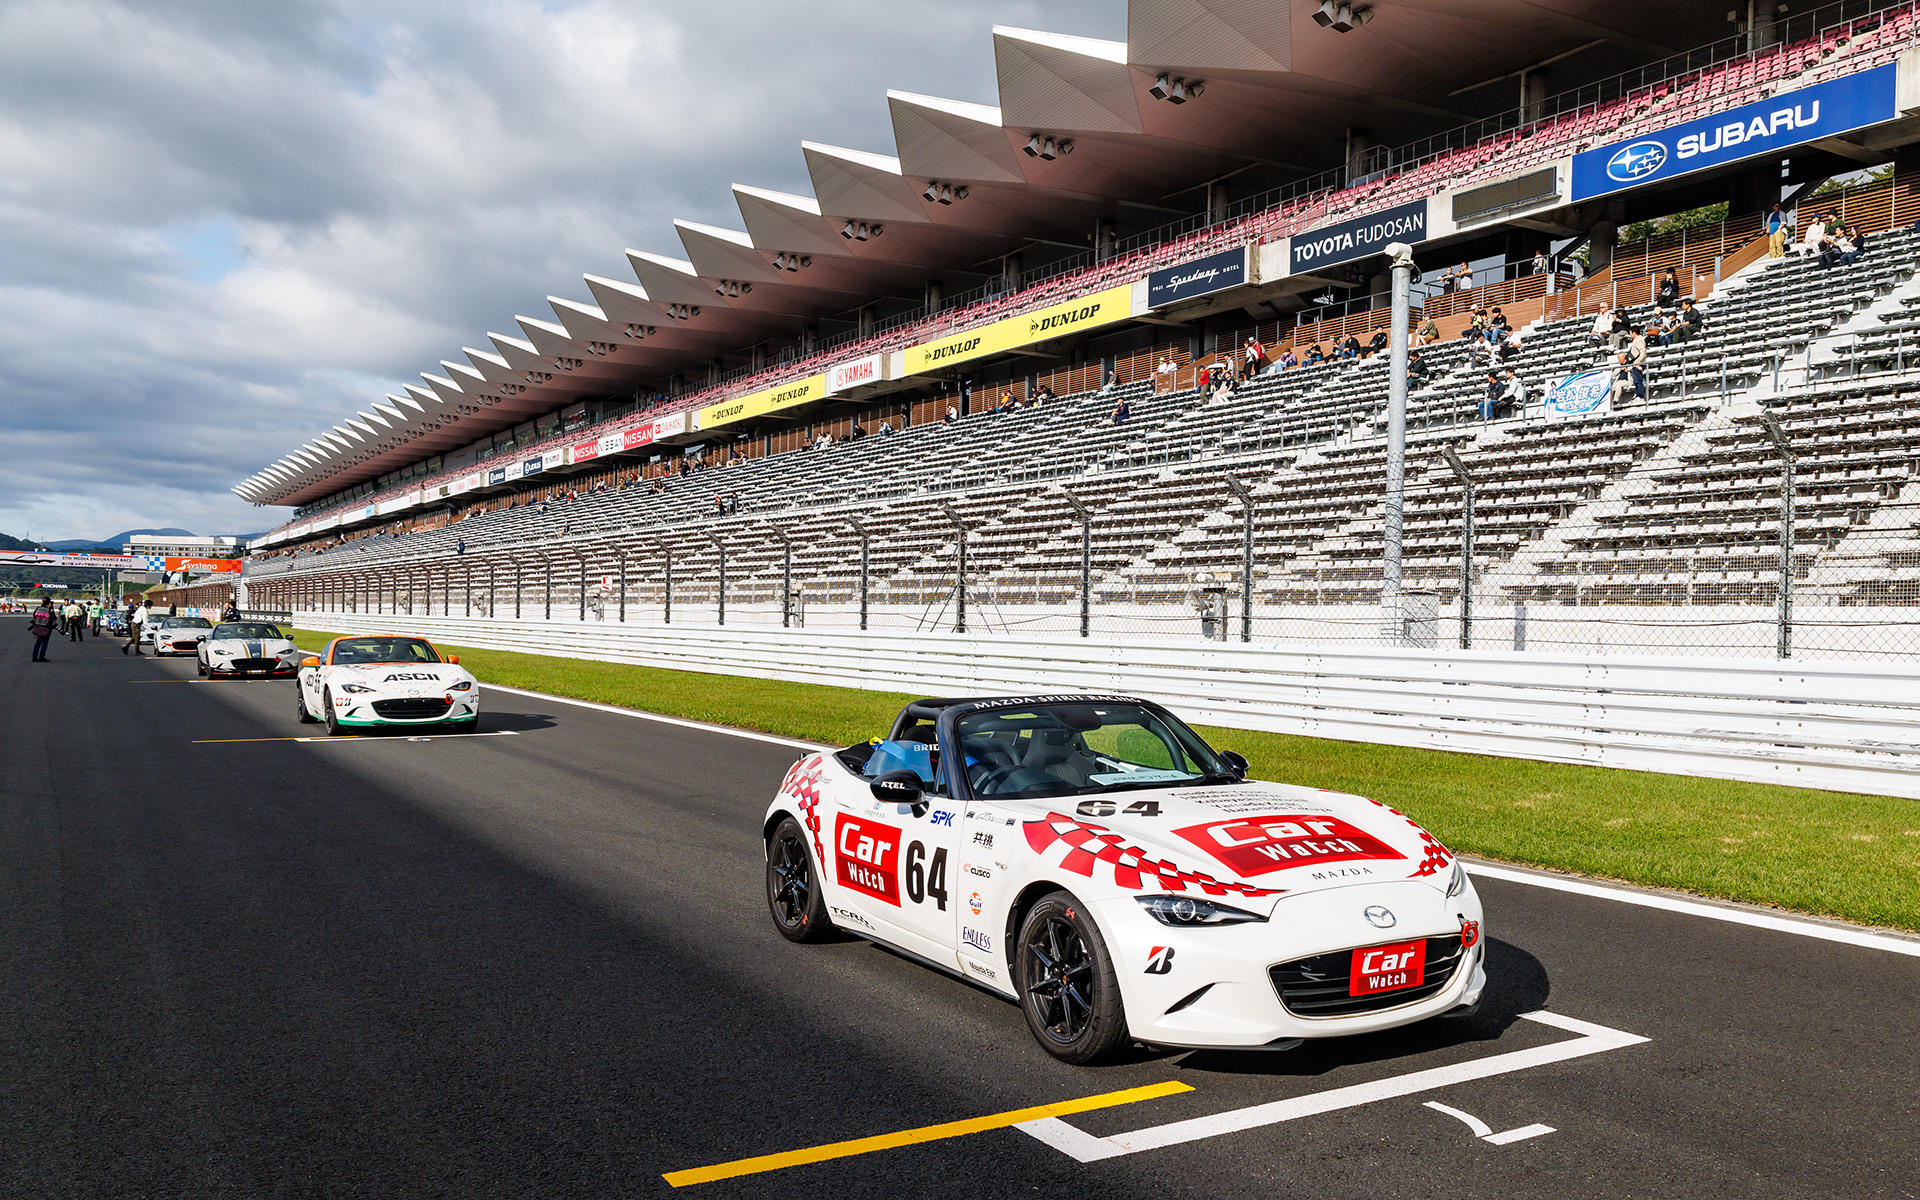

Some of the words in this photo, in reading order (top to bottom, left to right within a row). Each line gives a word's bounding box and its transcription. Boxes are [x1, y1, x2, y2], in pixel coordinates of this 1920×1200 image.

[1676, 100, 1820, 160] SUBARU
[1294, 231, 1354, 263] TOYOTA
[1355, 212, 1424, 246] FUDOSAN
[1166, 267, 1220, 293] Speedway
[1222, 264, 1240, 273] HOTEL
[1039, 304, 1101, 332] DUNLOP
[931, 337, 981, 361] DUNLOP
[844, 361, 874, 384] YAMAHA
[776, 385, 810, 403] DUNLOP
[716, 404, 744, 420] DUNLOP
[599, 437, 624, 452] NISSAN
[624, 427, 653, 447] NISSAN
[574, 444, 599, 459] NISSAN
[383, 672, 441, 683] ASCII
[973, 697, 1036, 710] MAZDA
[1038, 694, 1084, 703] SPIRIT
[1088, 695, 1142, 704] RACING
[864, 805, 886, 820] impress
[1076, 799, 1164, 818] 64
[930, 810, 956, 828] SPK
[840, 822, 892, 867] Car
[973, 831, 994, 848] 共挑
[1207, 821, 1337, 848] Car
[1254, 838, 1364, 861] Watch
[847, 861, 885, 892] Watch
[905, 840, 948, 912] 64
[1311, 867, 1374, 881] MAZDA
[969, 898, 982, 909] Gulf
[962, 926, 992, 950] ENDLESS
[1361, 950, 1416, 975] Car
[1369, 971, 1407, 989] Watch
